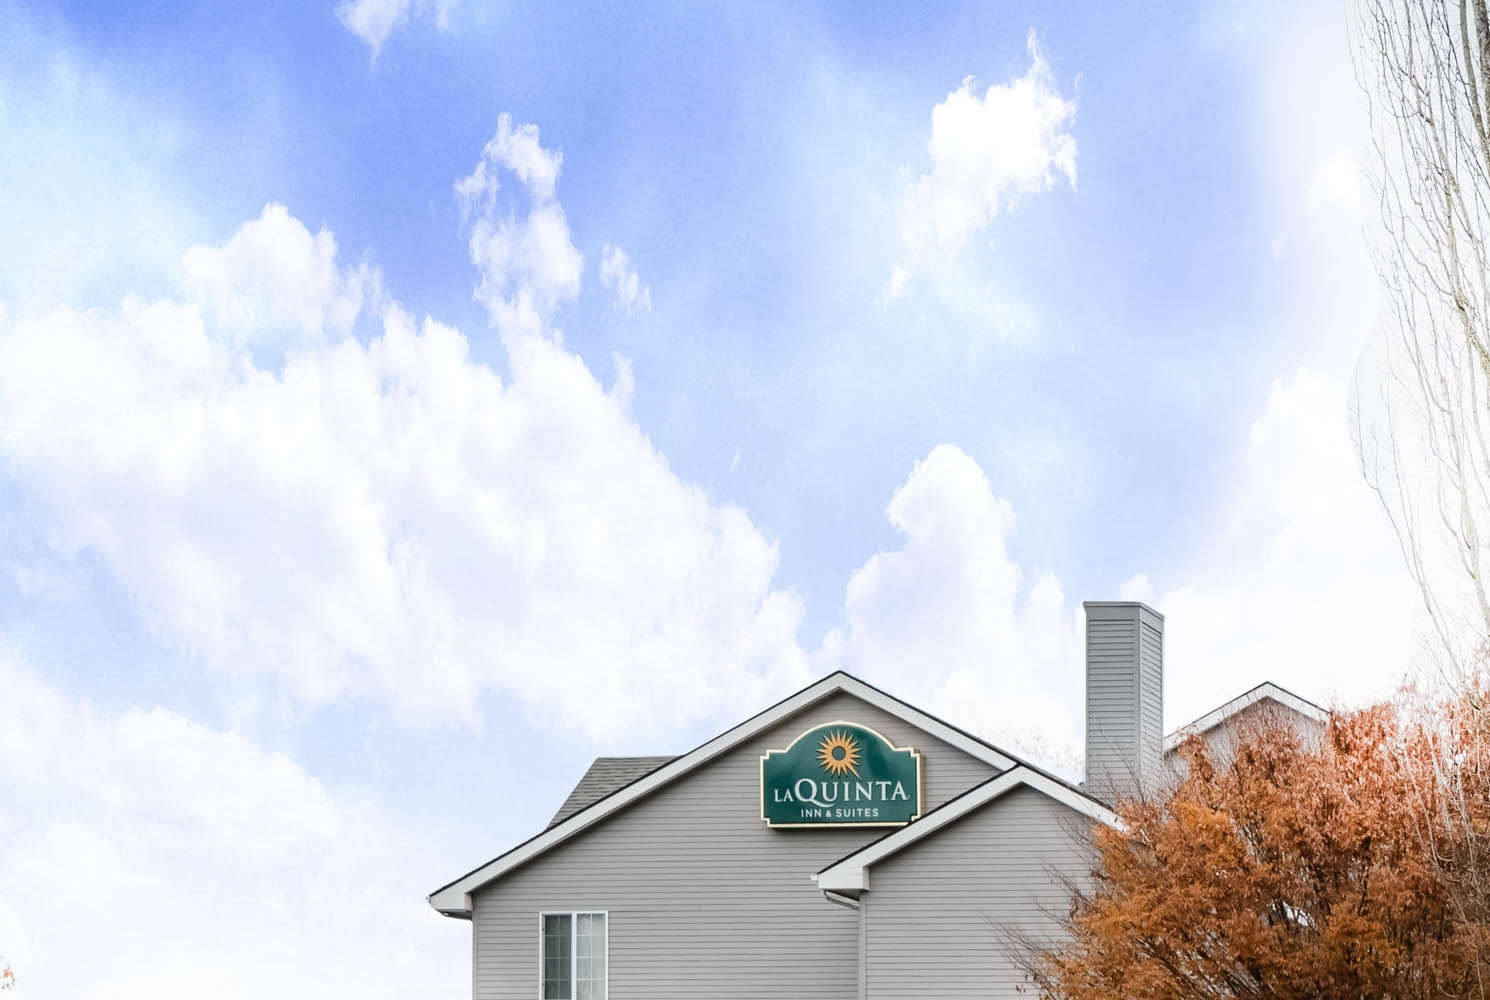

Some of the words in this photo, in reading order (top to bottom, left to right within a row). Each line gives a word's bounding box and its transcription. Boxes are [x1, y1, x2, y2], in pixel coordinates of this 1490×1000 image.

[774, 788, 794, 802] LA
[794, 778, 909, 808] QUINTA
[801, 809, 822, 818] INN
[826, 809, 832, 818] &
[835, 808, 879, 817] SUITES
